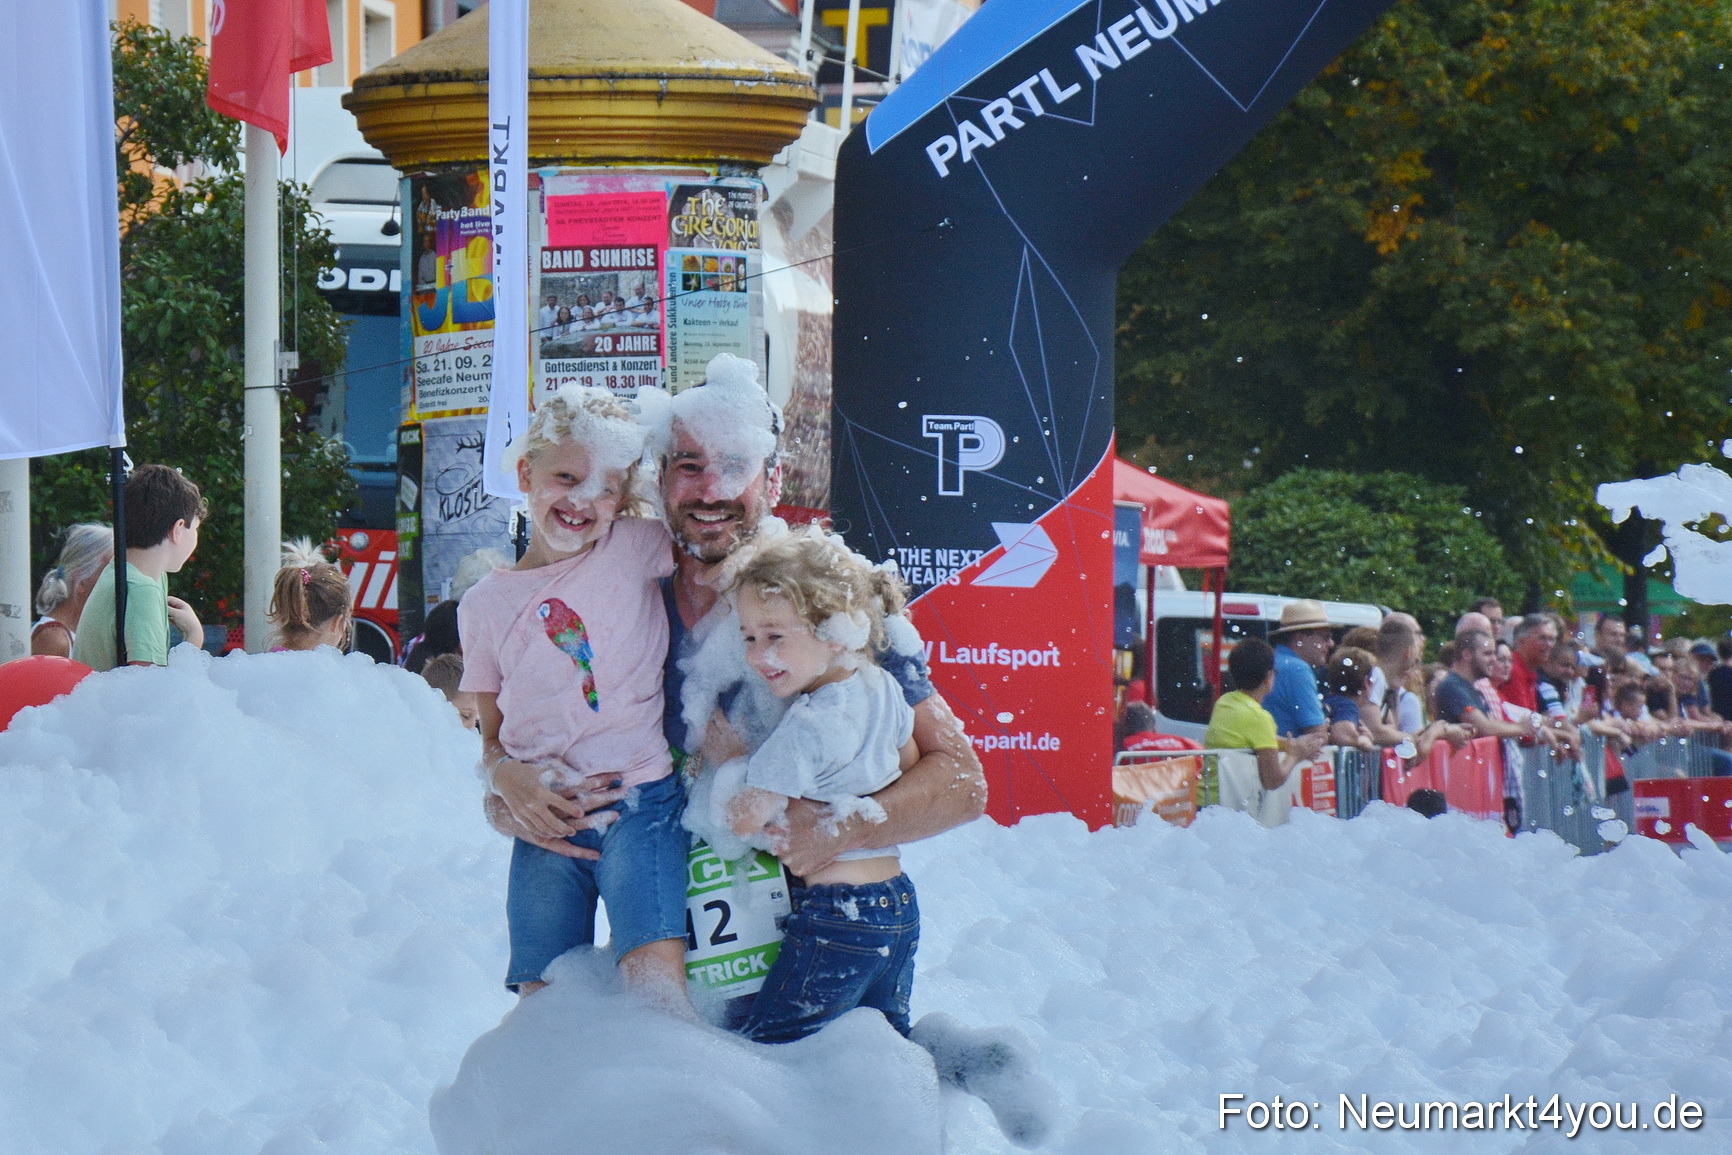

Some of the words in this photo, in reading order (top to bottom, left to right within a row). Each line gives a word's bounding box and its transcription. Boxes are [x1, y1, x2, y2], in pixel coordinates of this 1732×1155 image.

[925, 67, 1082, 178] PARTL
[541, 250, 584, 269] BAND
[590, 248, 655, 268] SUNRISE
[594, 337, 613, 352] 20
[616, 335, 657, 352] JAHRE
[668, 332, 677, 363] andere
[416, 363, 430, 374] Sa.
[434, 359, 451, 371] 21.
[455, 356, 476, 369] 09.
[545, 361, 609, 373] Gottesdienst
[612, 361, 618, 371] &
[621, 359, 657, 370] Konzert
[417, 375, 453, 387] Seecafe
[668, 366, 677, 383] und
[420, 385, 483, 398] Benefizkonzert
[928, 422, 952, 430] Team
[898, 547, 932, 566] THE
[935, 548, 984, 568] NEXT
[901, 566, 962, 586] YEARS
[940, 640, 1061, 671] Laufsport
[770, 890, 783, 900] E6
[689, 951, 770, 984] TRICK
